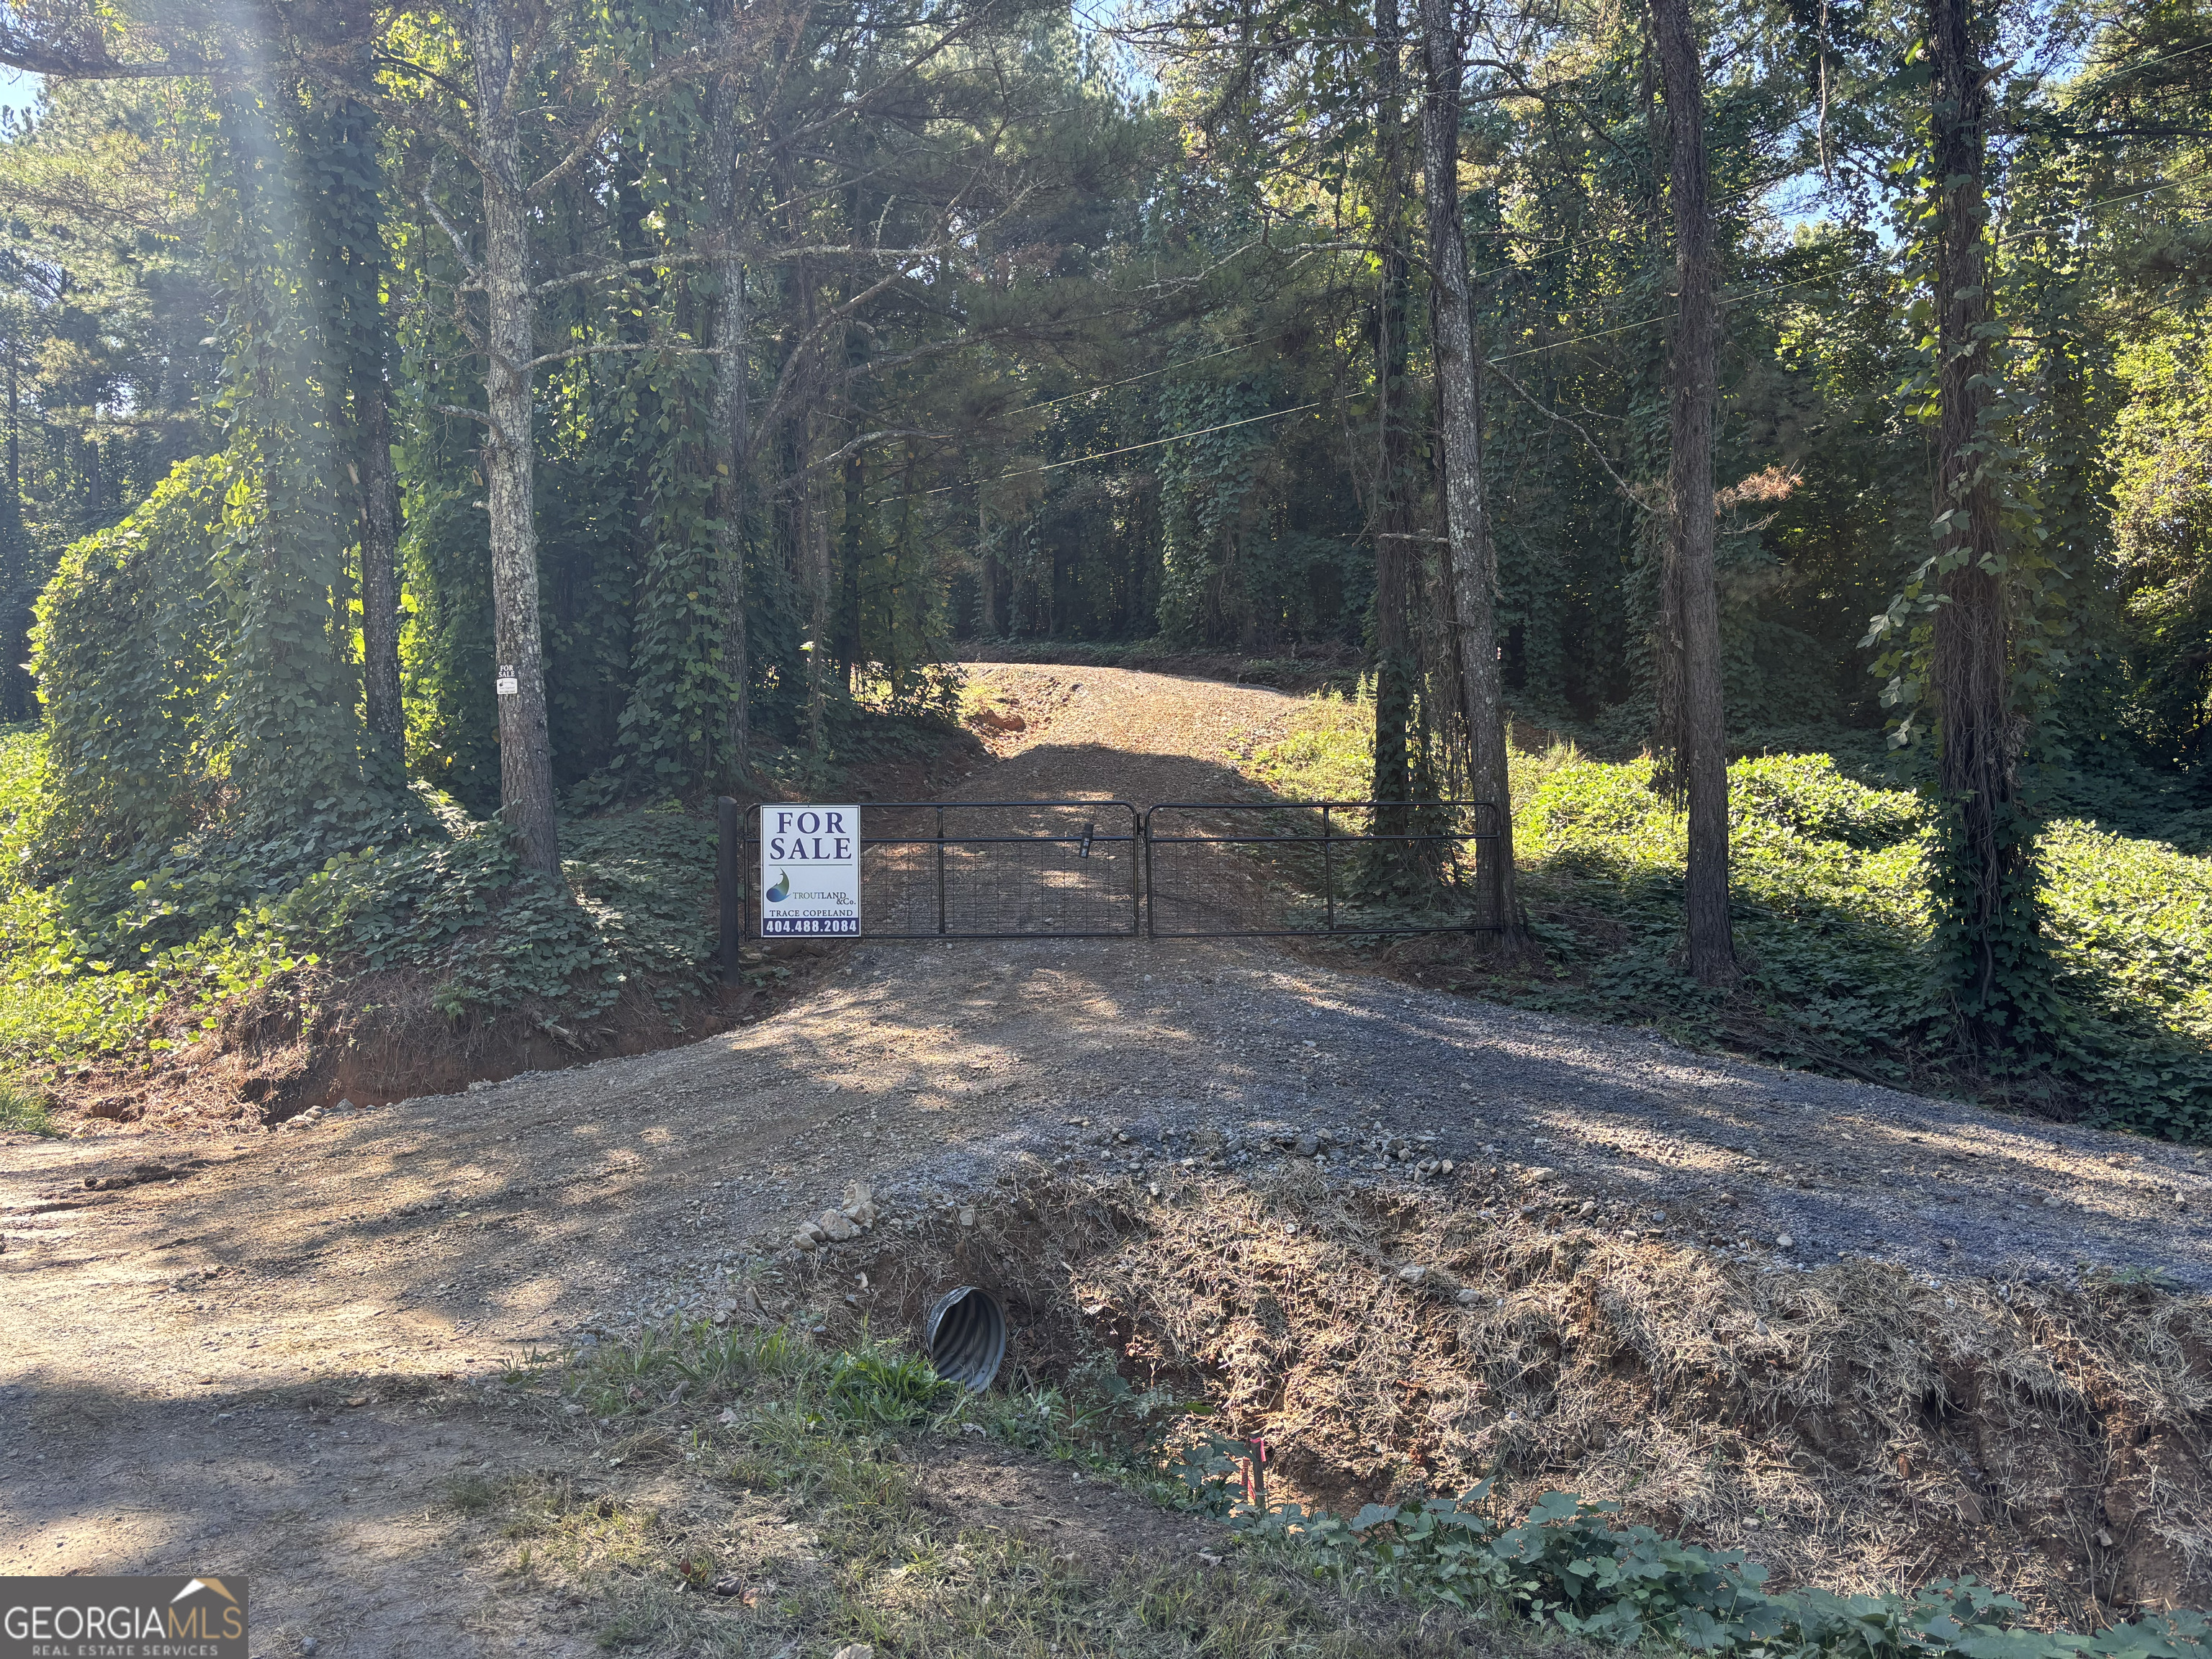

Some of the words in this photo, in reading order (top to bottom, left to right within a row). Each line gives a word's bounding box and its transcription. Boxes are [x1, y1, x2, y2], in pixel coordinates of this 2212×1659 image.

[776, 811, 846, 834] FOR
[770, 837, 852, 860] SALE
[766, 920, 856, 932] 404.488.2084
